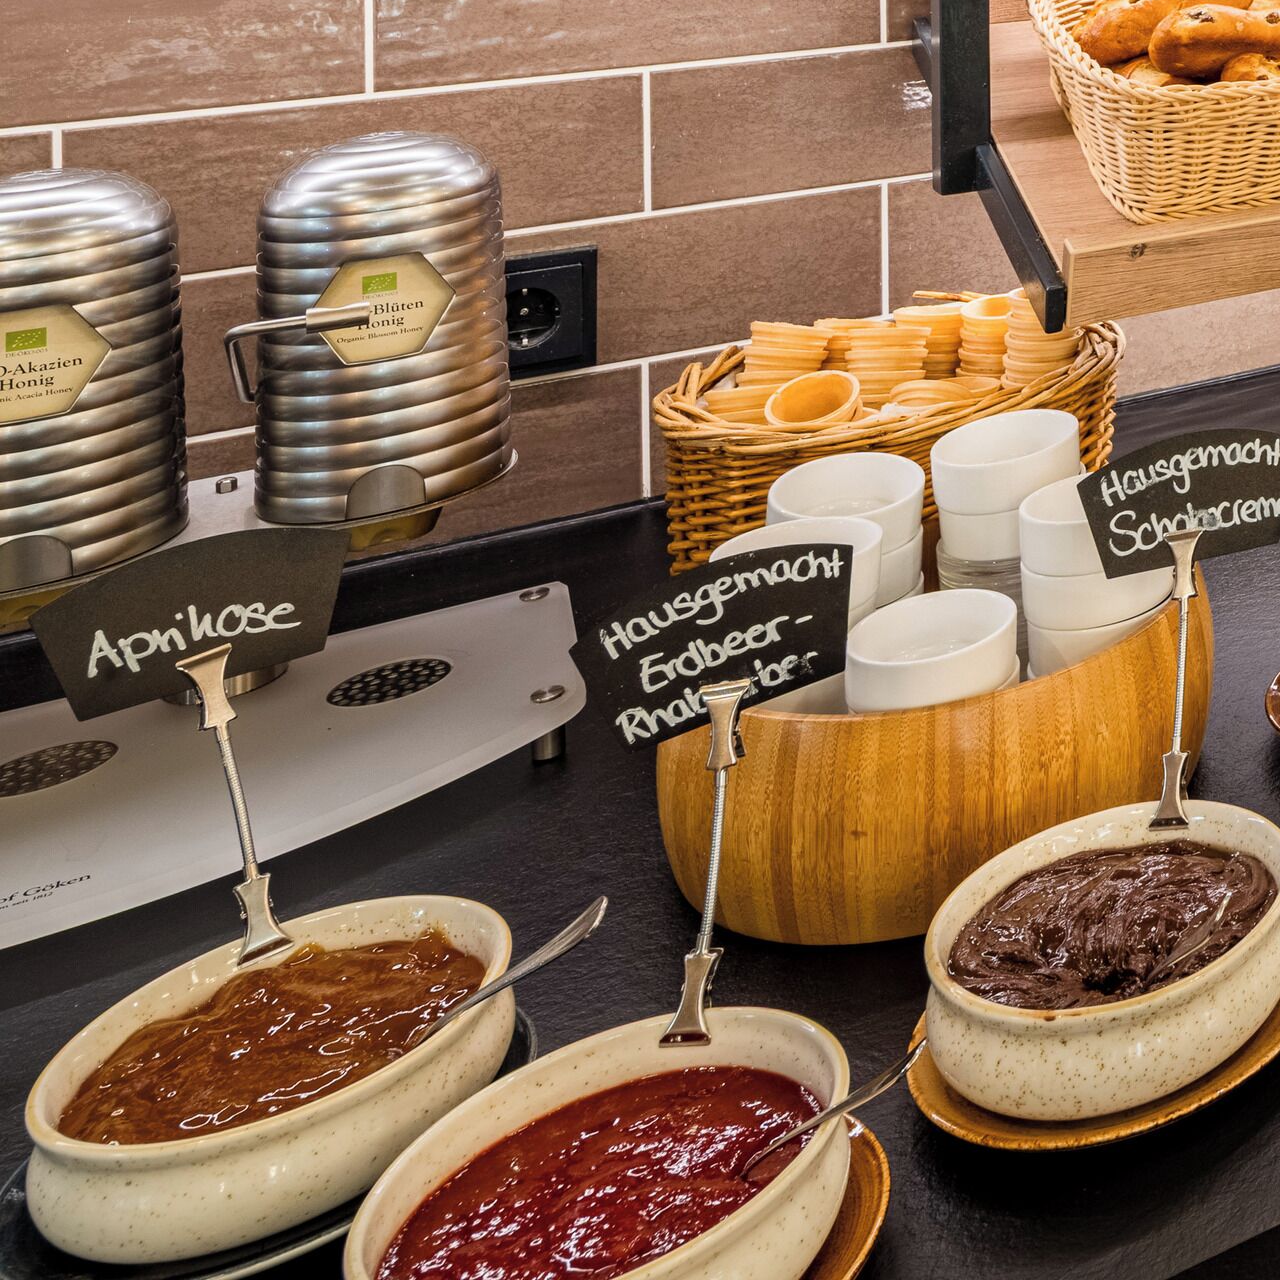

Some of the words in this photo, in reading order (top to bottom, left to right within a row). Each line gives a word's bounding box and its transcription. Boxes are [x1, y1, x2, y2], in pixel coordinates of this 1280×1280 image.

[336, 336, 367, 345] Organic
[368, 331, 398, 340] Blossom
[400, 326, 424, 335] Honey
[0, 375, 55, 391] Honig
[15, 392, 43, 401] Acacia
[45, 386, 74, 396] Honey
[600, 549, 844, 660] Hausgemacht
[640, 615, 813, 694] Erdbeer-
[616, 651, 818, 744] Rhabber
[23, 874, 91, 897] Göken
